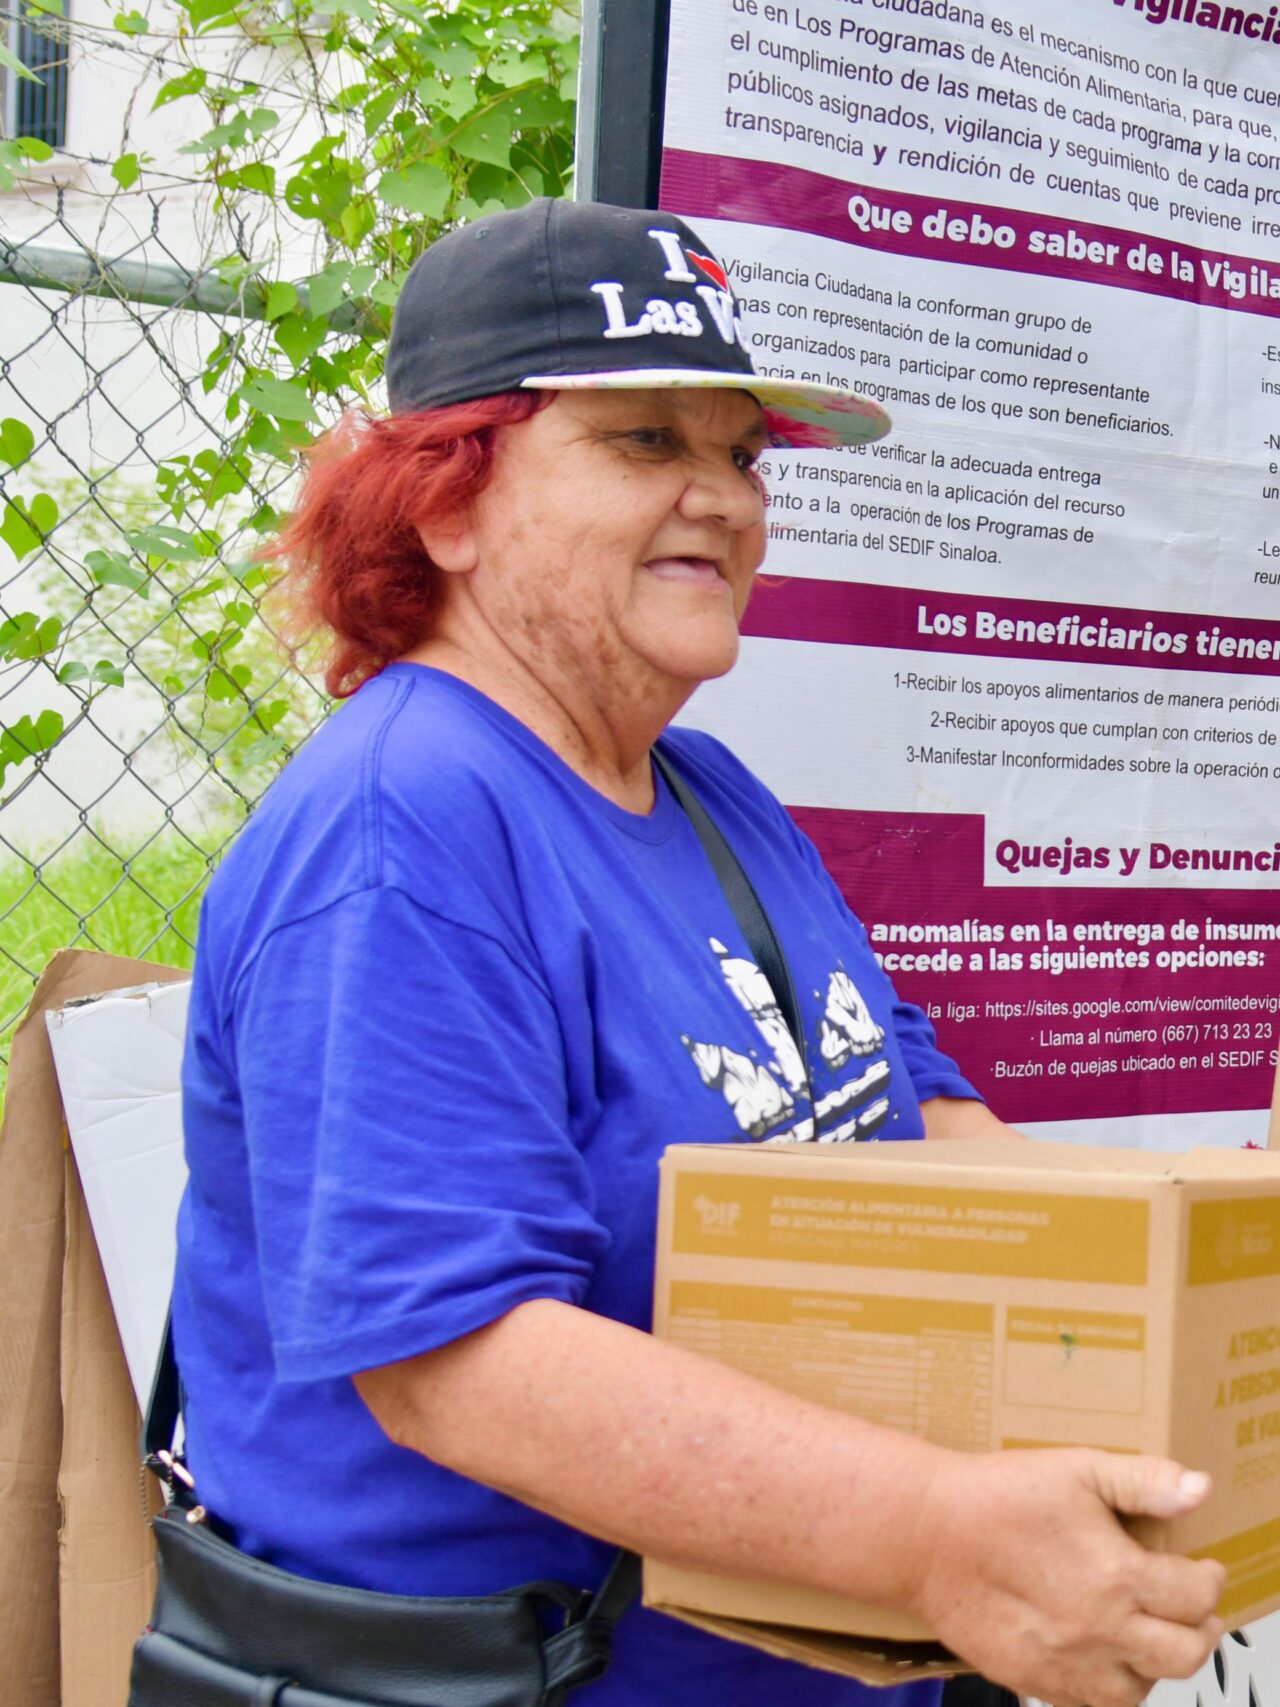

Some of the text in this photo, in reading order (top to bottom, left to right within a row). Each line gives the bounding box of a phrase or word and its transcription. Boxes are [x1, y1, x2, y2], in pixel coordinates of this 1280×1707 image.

[764, 4, 788, 26] en
[795, 7, 832, 37] Los
[839, 18, 965, 61] Programas
[971, 44, 995, 68] de
[999, 51, 1081, 90] Atención
[1085, 74, 1186, 121] Alimentaria,
[1192, 108, 1233, 130] para
[1238, 119, 1277, 142] que,
[727, 69, 814, 107] públicos
[819, 94, 935, 135] asignados,
[944, 114, 1043, 151] vigilancia
[1048, 137, 1060, 158] y
[1066, 141, 1170, 182] seguimiento
[1177, 168, 1199, 189] de
[1203, 177, 1249, 199] cada
[647, 230, 697, 283] I
[847, 195, 913, 234] Que
[921, 209, 1016, 249] debo
[1027, 229, 1120, 266] saber
[1126, 243, 1164, 275] de
[1171, 251, 1195, 283] la
[589, 281, 704, 339] Las
[721, 257, 1092, 334] Vigilancia Ciudadana la conforman grupo de
[751, 332, 1150, 404] organizados para participar como representante
[778, 462, 1126, 518] y transparencia en la aplicación del recurso
[917, 605, 967, 637] Los
[975, 611, 1189, 654] Beneficiarios
[894, 672, 958, 692] 1-Recibir
[961, 677, 982, 695] los
[986, 682, 1041, 701] apoyos
[1045, 683, 1139, 704] alimentarios
[1143, 689, 1164, 706] de
[1167, 694, 1224, 709] manera
[906, 745, 998, 766] 3-Manifestar
[1001, 750, 1125, 772] Inconformidades
[1129, 756, 1171, 774] sobre
[1175, 758, 1189, 774] la
[1193, 762, 1269, 779] operación
[995, 836, 1111, 876] Quejas
[1118, 847, 1141, 877] y
[870, 918, 1005, 943] anomalías
[1010, 924, 1041, 942] en
[1046, 918, 1068, 942] la
[1072, 920, 1165, 947] entrega
[1170, 918, 1200, 941] de
[968, 953, 984, 972] a
[989, 947, 1024, 971] las
[1029, 944, 1150, 975] siguientes
[1155, 943, 1265, 973] opciones:
[926, 1002, 942, 1019] la
[947, 1002, 980, 1023] liga:
[1040, 1022, 1273, 1047] Llama al número (667) 713 23 23
[1047, 1059, 1067, 1076] de
[1070, 1057, 1118, 1078] quejas
[1121, 1054, 1176, 1072] ubicado
[1179, 1056, 1197, 1069] en
[1201, 1052, 1214, 1069] el
[1218, 1050, 1265, 1068] SEDIF
